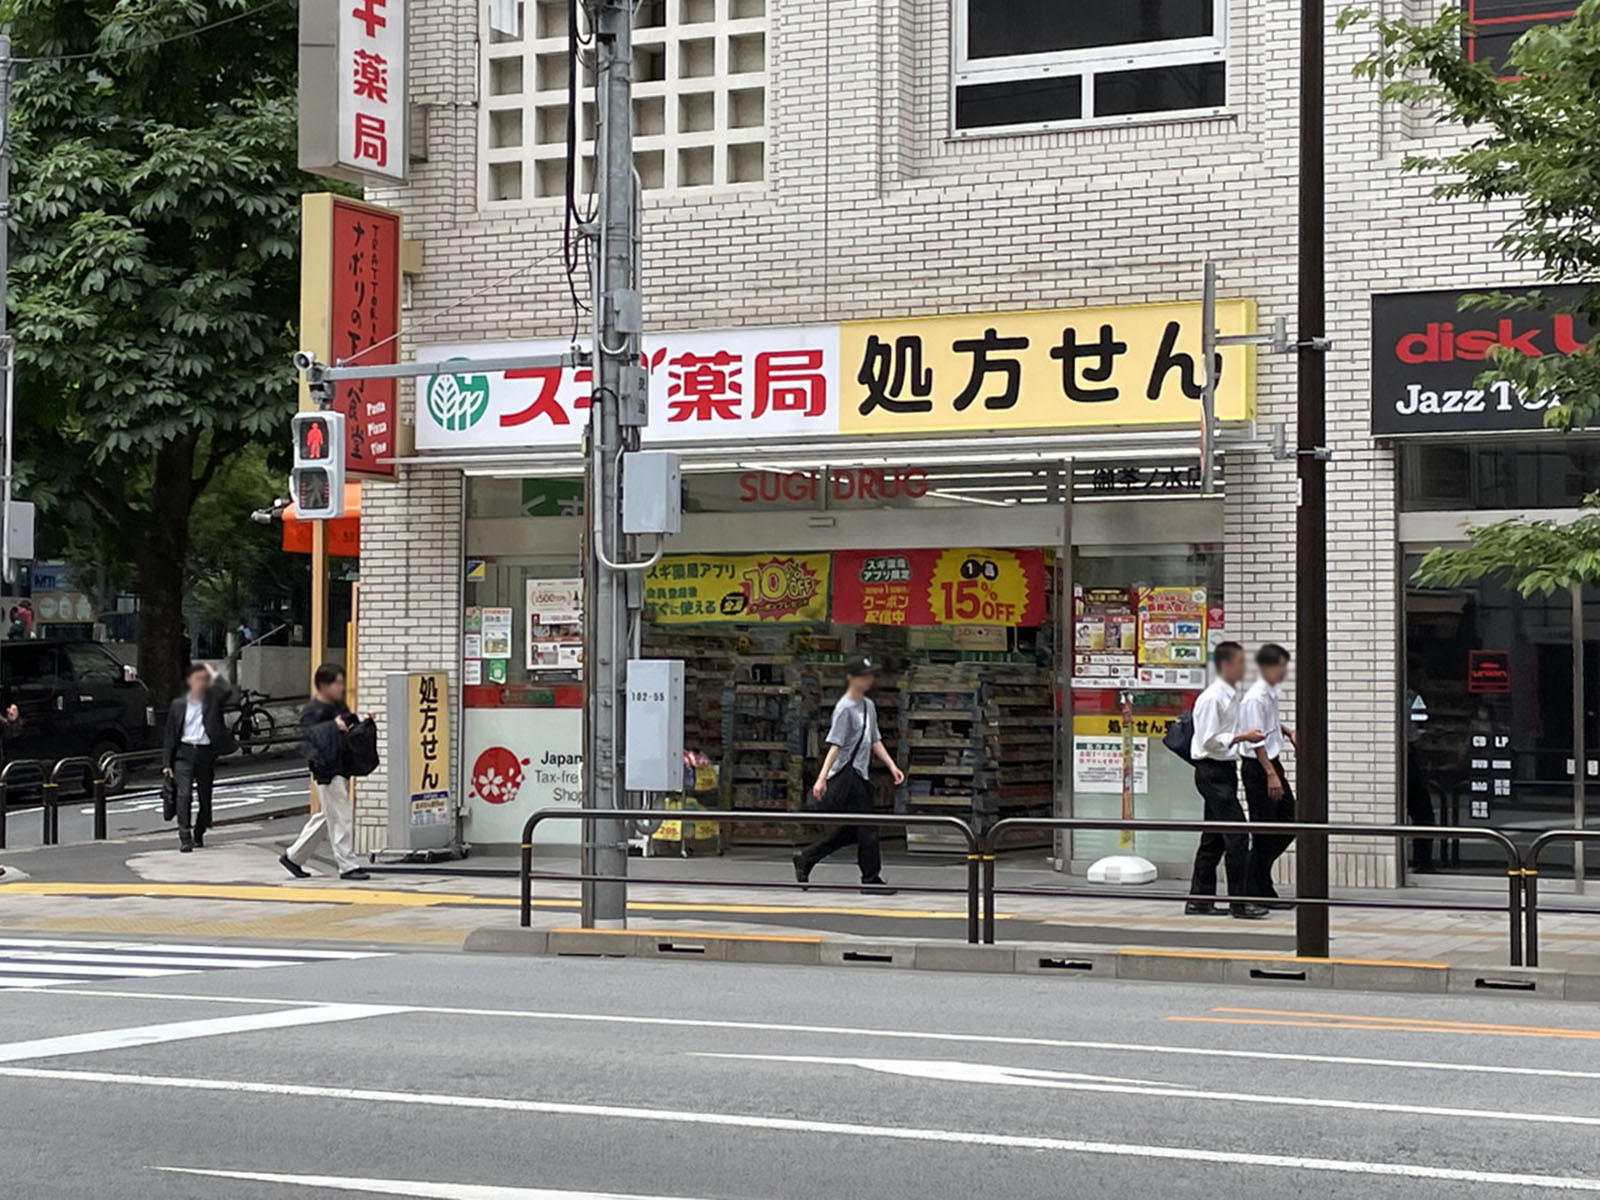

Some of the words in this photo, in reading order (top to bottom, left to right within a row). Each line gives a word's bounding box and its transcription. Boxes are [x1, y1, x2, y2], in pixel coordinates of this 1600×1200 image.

[1395, 317, 1544, 364] disk
[857, 320, 1223, 416] 処方せん
[1395, 383, 1486, 415] Jazz
[739, 470, 818, 503] SUGI
[832, 466, 931, 500] DRUG
[419, 676, 439, 790] 処方せん
[1494, 735, 1510, 748] LP
